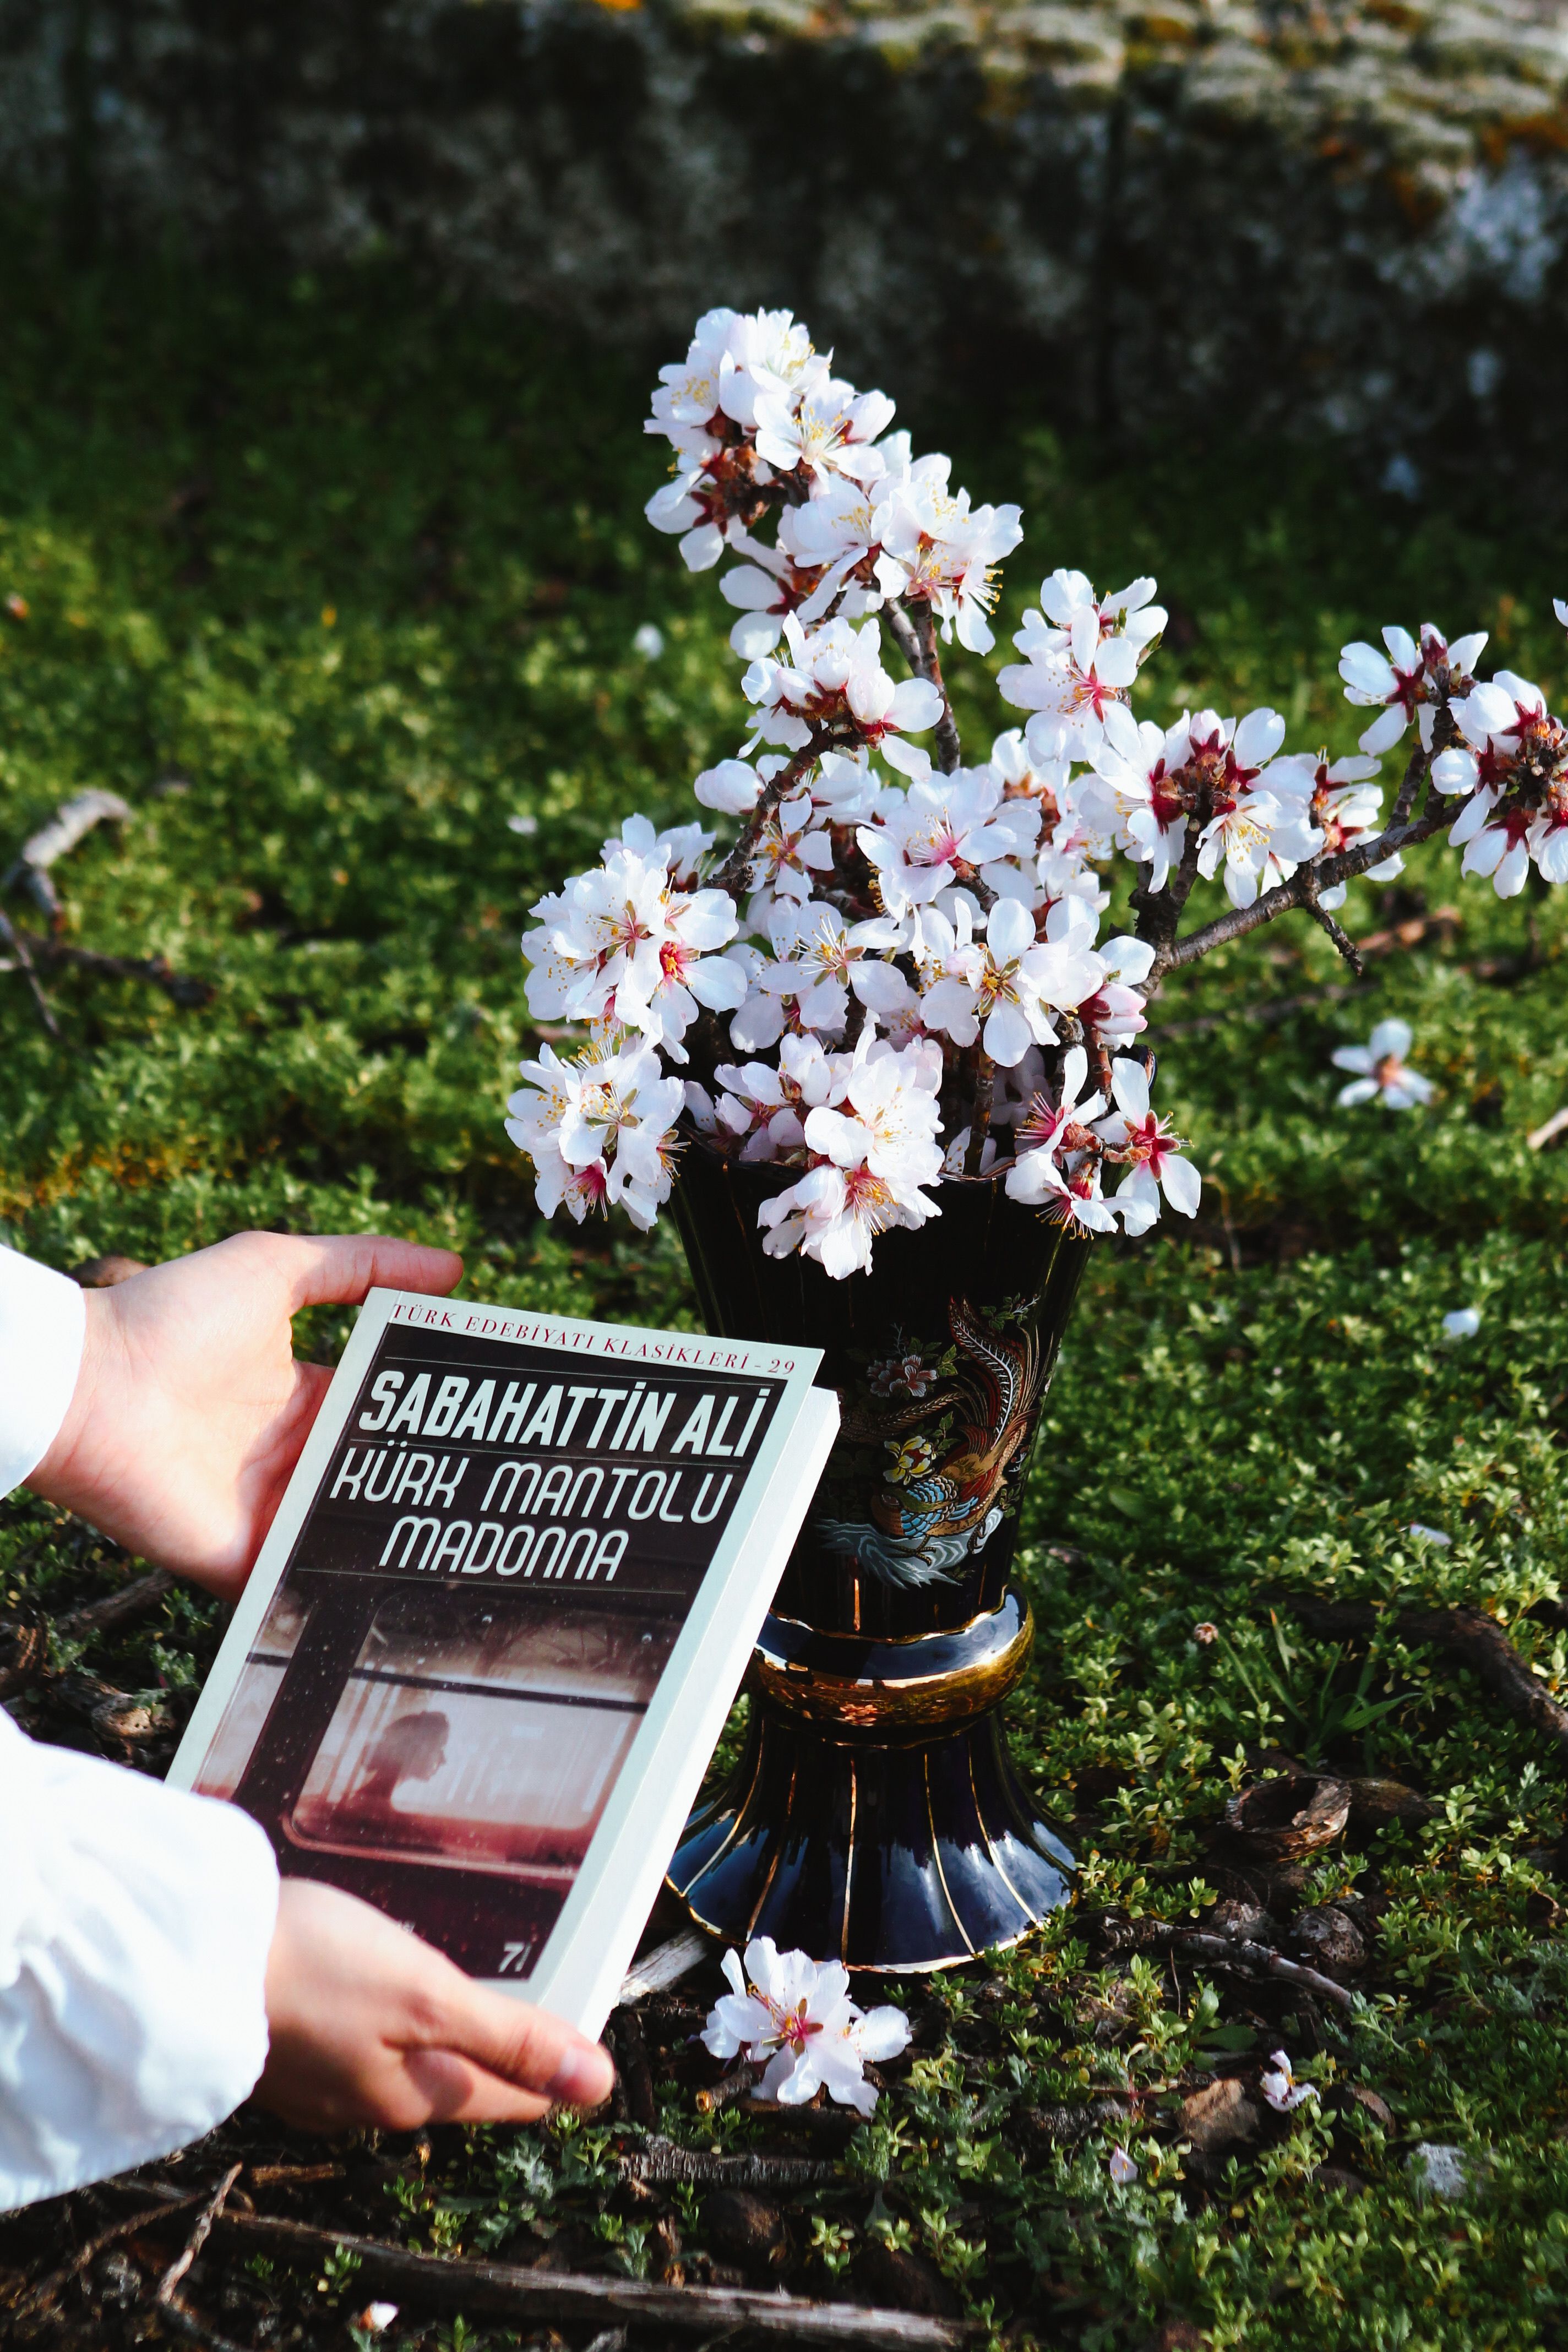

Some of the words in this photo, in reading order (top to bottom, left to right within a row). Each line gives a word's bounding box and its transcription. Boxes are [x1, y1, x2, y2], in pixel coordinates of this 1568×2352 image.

[393, 1303, 456, 1327] TÜRK
[464, 1316, 595, 1349] EDEBİYATI
[603, 1338, 749, 1370] KLASİKLERİ
[767, 1359, 795, 1375] 29
[358, 1370, 677, 1452] SABAHATTİN
[670, 1389, 770, 1457] ALİ
[329, 1440, 470, 1509] KÜRK
[480, 1461, 733, 1524] MANTOLU
[379, 1516, 629, 1581] MADONNA
